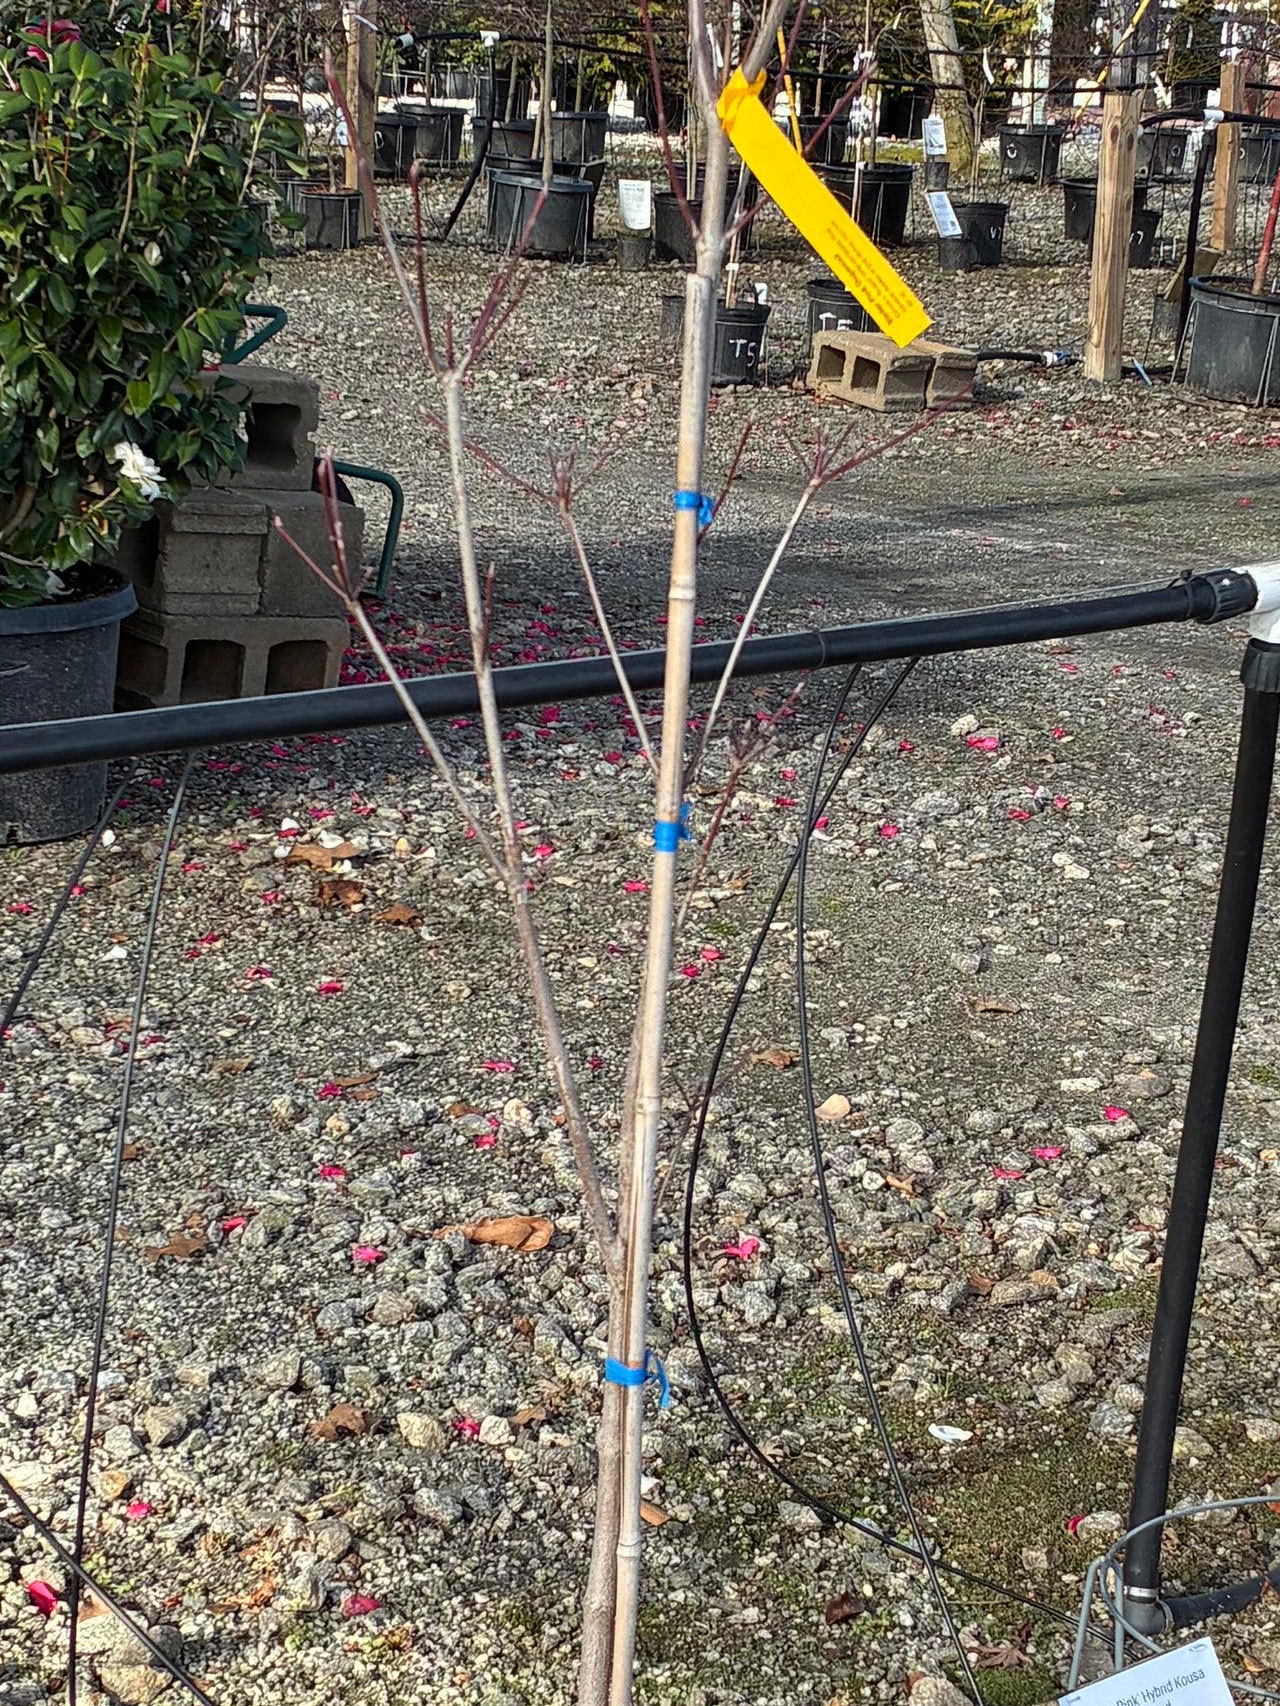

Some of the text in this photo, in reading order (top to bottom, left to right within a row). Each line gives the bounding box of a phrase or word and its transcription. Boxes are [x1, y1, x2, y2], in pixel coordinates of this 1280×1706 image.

[729, 339, 756, 367] T5
[1141, 1680, 1174, 1703] Hybrid
[1173, 1669, 1206, 1689] Kousa
